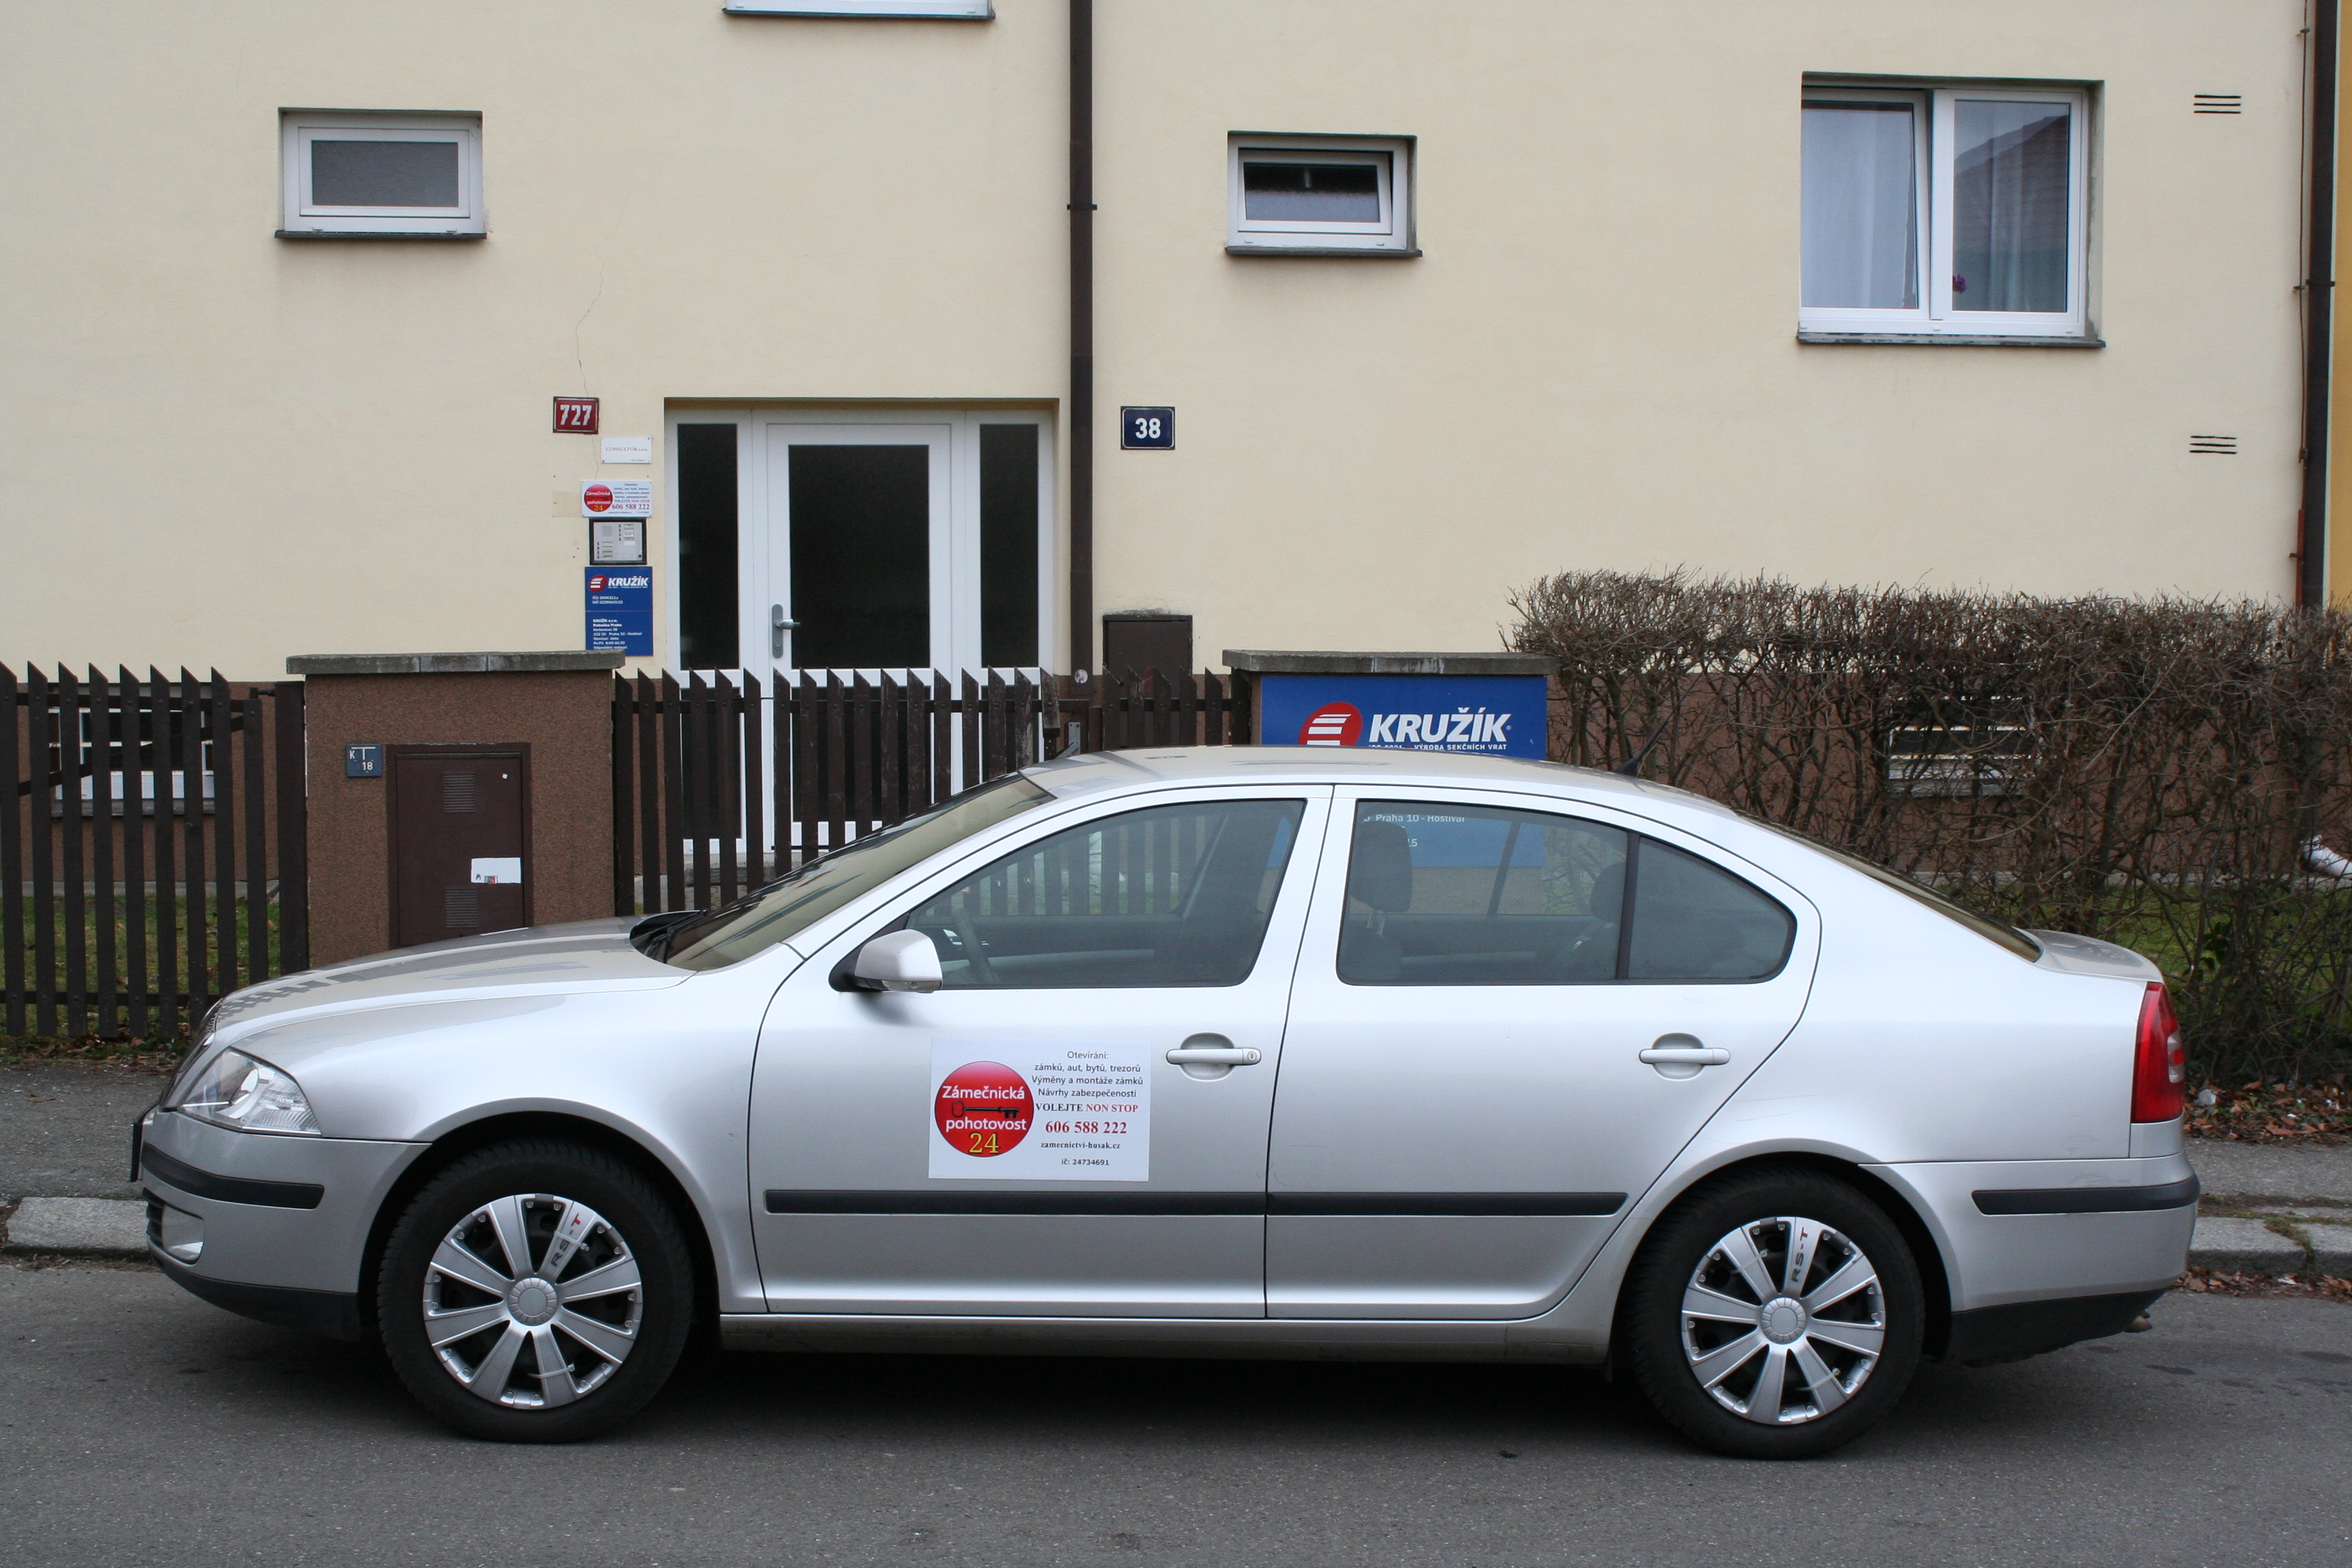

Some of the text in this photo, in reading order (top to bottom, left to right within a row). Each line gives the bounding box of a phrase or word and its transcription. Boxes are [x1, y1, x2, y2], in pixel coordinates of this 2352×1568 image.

[560, 404, 592, 425] 727
[1135, 417, 1161, 439] 38
[608, 576, 649, 587] KRUŽÍK
[1369, 706, 1512, 743] KRUŽÍK
[362, 762, 373, 770] 18
[1375, 814, 1403, 822] Praha
[1067, 1051, 1109, 1059] Otevírání:
[1034, 1062, 1064, 1072] zámků,
[1086, 1064, 1107, 1073] bytů,
[1110, 1064, 1141, 1073] trezorů
[1032, 1075, 1066, 1085] Výměny
[1076, 1076, 1113, 1084] montáže
[1115, 1077, 1143, 1085] zámků
[942, 1085, 1025, 1099] Zámečnická
[1038, 1088, 1068, 1098] Návrhy
[1035, 1103, 1139, 1113] VOLEJTE NON STOP
[946, 1116, 1026, 1132] pohotovost
[1045, 1120, 1127, 1134] 606 588 222
[969, 1132, 1000, 1154] 24
[1791, 1226, 1808, 1282] RS-T
